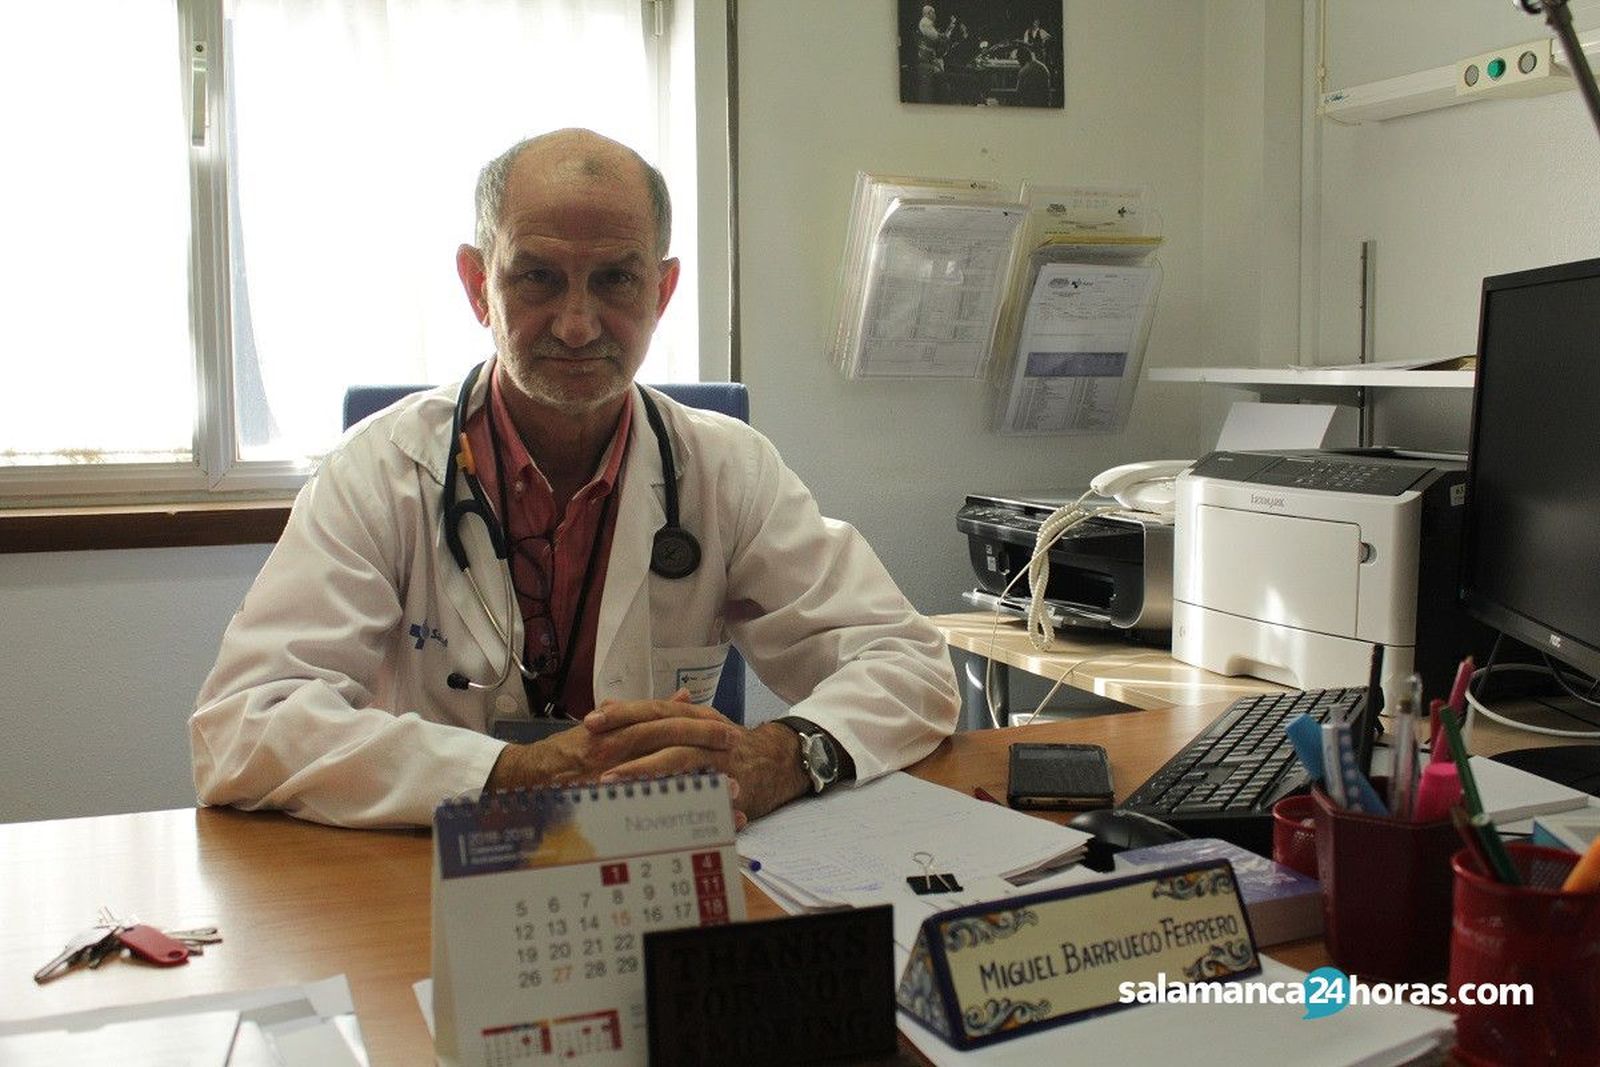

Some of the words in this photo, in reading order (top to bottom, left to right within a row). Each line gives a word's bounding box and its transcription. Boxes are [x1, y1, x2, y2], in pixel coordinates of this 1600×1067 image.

[640, 862, 652, 879] 2
[671, 858, 683, 875] 3
[515, 901, 528, 918] 5
[547, 897, 560, 914] 6
[580, 893, 591, 908] 7
[612, 889, 624, 905] 8
[643, 884, 655, 901] 9
[672, 881, 691, 897] 10
[515, 922, 534, 941] 12
[547, 919, 567, 936] 13
[580, 915, 599, 931] 14
[643, 905, 662, 922] 16
[674, 901, 692, 918] 17
[518, 946, 538, 963] 19
[549, 942, 571, 960] 20
[583, 938, 602, 956] 21
[615, 933, 634, 951] 22
[519, 970, 541, 988] 26
[552, 965, 574, 983] 27
[585, 961, 607, 979] 28
[617, 956, 639, 974] 29
